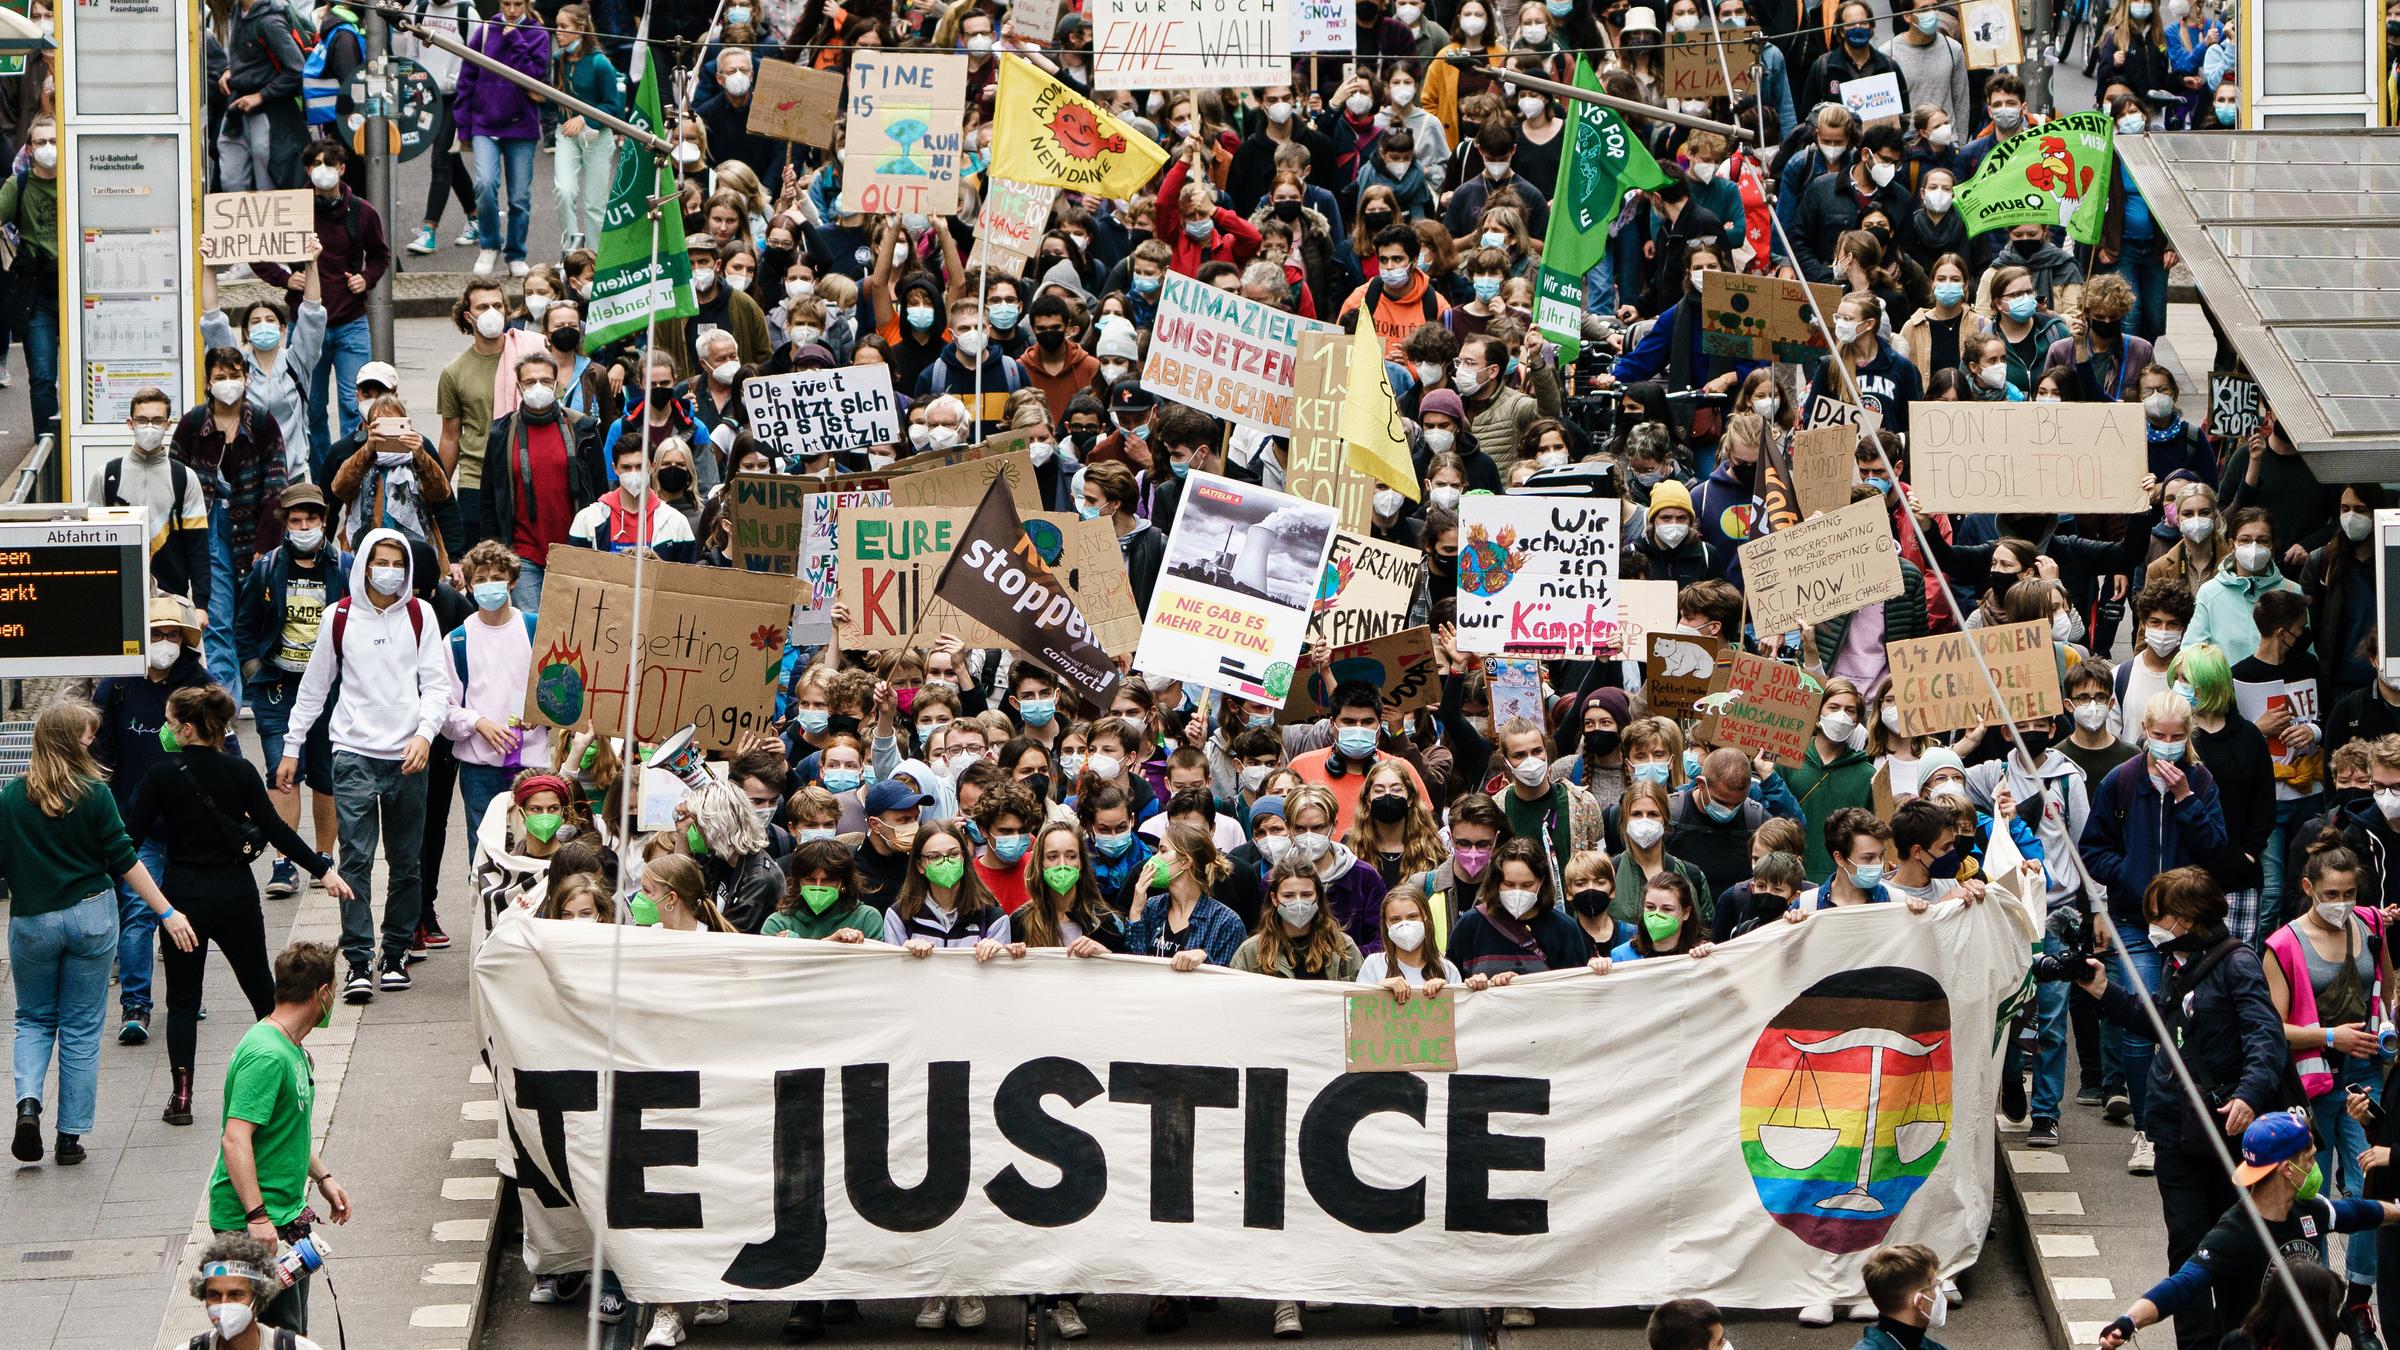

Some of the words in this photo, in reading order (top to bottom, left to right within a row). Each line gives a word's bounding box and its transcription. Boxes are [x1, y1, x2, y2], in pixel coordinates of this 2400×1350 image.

[110, 5, 159, 14] Pasedagplatz
[1113, 0, 1166, 13] NUR
[1191, 0, 1274, 12] NOCH
[1304, 4, 1342, 19] SNOW
[1095, 21, 1184, 71] EINE
[1198, 19, 1282, 68] WAHL
[855, 63, 935, 89] TIME
[1675, 69, 1747, 90] KLIMA
[853, 95, 873, 118] IS
[922, 133, 959, 151] RUN
[1030, 135, 1067, 178] NEIN
[1601, 125, 1625, 159] FOR
[90, 154, 138, 162] S+U-Bahnhof
[90, 163, 144, 171] Friedrichstraße
[932, 155, 952, 168] NI
[929, 170, 952, 181] NG
[213, 196, 292, 230] SAVE
[861, 183, 928, 214] OUT
[206, 235, 236, 259] OUR
[238, 231, 312, 257] PLANET
[1543, 273, 1556, 294] Wir
[1724, 276, 1758, 292] früher
[1156, 313, 1296, 387] UMSETZEN
[1143, 351, 1213, 404] ABER
[1921, 408, 2016, 447] DON'T
[2030, 407, 2073, 446] BE
[2095, 409, 2126, 448] A
[1925, 451, 2028, 498] FOSSIL
[2032, 453, 2118, 500] FOOL
[738, 480, 801, 509] WIR
[816, 493, 893, 510] NIEMAND
[1199, 487, 1232, 501] DATTELN
[1551, 507, 1609, 533] Wir
[47, 530, 101, 543] Abfahrt
[106, 530, 118, 542] in
[856, 520, 952, 560] EURE
[1746, 536, 1776, 559] STOP
[1784, 515, 1842, 542] HESITATING
[1750, 556, 1775, 575] STOP
[1784, 522, 1874, 561] PROCRASTINATING
[0, 552, 31, 565] een
[1355, 546, 1418, 589] BRENNT
[1753, 571, 1780, 590] STOP
[1788, 543, 1870, 577] MASTURBATING
[1806, 550, 1824, 561] AND
[1540, 578, 1611, 608] nicht,
[1756, 589, 1788, 619] ACT
[1797, 573, 1844, 606] NOW
[1764, 604, 1810, 634] AGAINST
[1811, 593, 1852, 617] CLIMATE
[1856, 580, 1891, 601] CHANGE
[1176, 596, 1203, 613] NIE
[1206, 604, 1241, 624] GAB
[1244, 615, 1265, 630] ES
[1333, 609, 1406, 646] PENNT
[1459, 600, 1504, 628] wir
[1511, 601, 1619, 650] Kämpfen
[0, 624, 24, 637] en
[1155, 611, 1200, 633] MEHR
[1204, 623, 1231, 640] ZU
[1233, 631, 1269, 653] TUN.
[628, 614, 739, 686] getting
[1060, 650, 1082, 668] Bewegt
[1083, 663, 1104, 677] Politik
[1892, 644, 1928, 673] 1,4
[1043, 647, 1115, 692] campact!
[1734, 657, 1762, 682] ICH
[1771, 667, 1800, 688] BIN
[1904, 671, 1974, 704] GEGEN
[1989, 663, 2031, 689] DEN
[1651, 679, 1685, 694] Rettet
[1730, 676, 1753, 692] MIR
[1760, 684, 1811, 708] SICHER
[1750, 695, 1763, 704] DIE
[586, 661, 702, 742] HOT
[694, 704, 773, 746] again
[1721, 718, 1767, 738] DACHTEN
[1719, 731, 1737, 741] SIE
[1740, 735, 1774, 751] HÄTTEN
[1778, 747, 1806, 761] NOCH
[1351, 995, 1449, 1024] FRIDAYS
[1384, 1021, 1420, 1037] FOR
[1350, 1036, 1449, 1065] FUTURE
[721, 1055, 1551, 1290] JUSTICE
